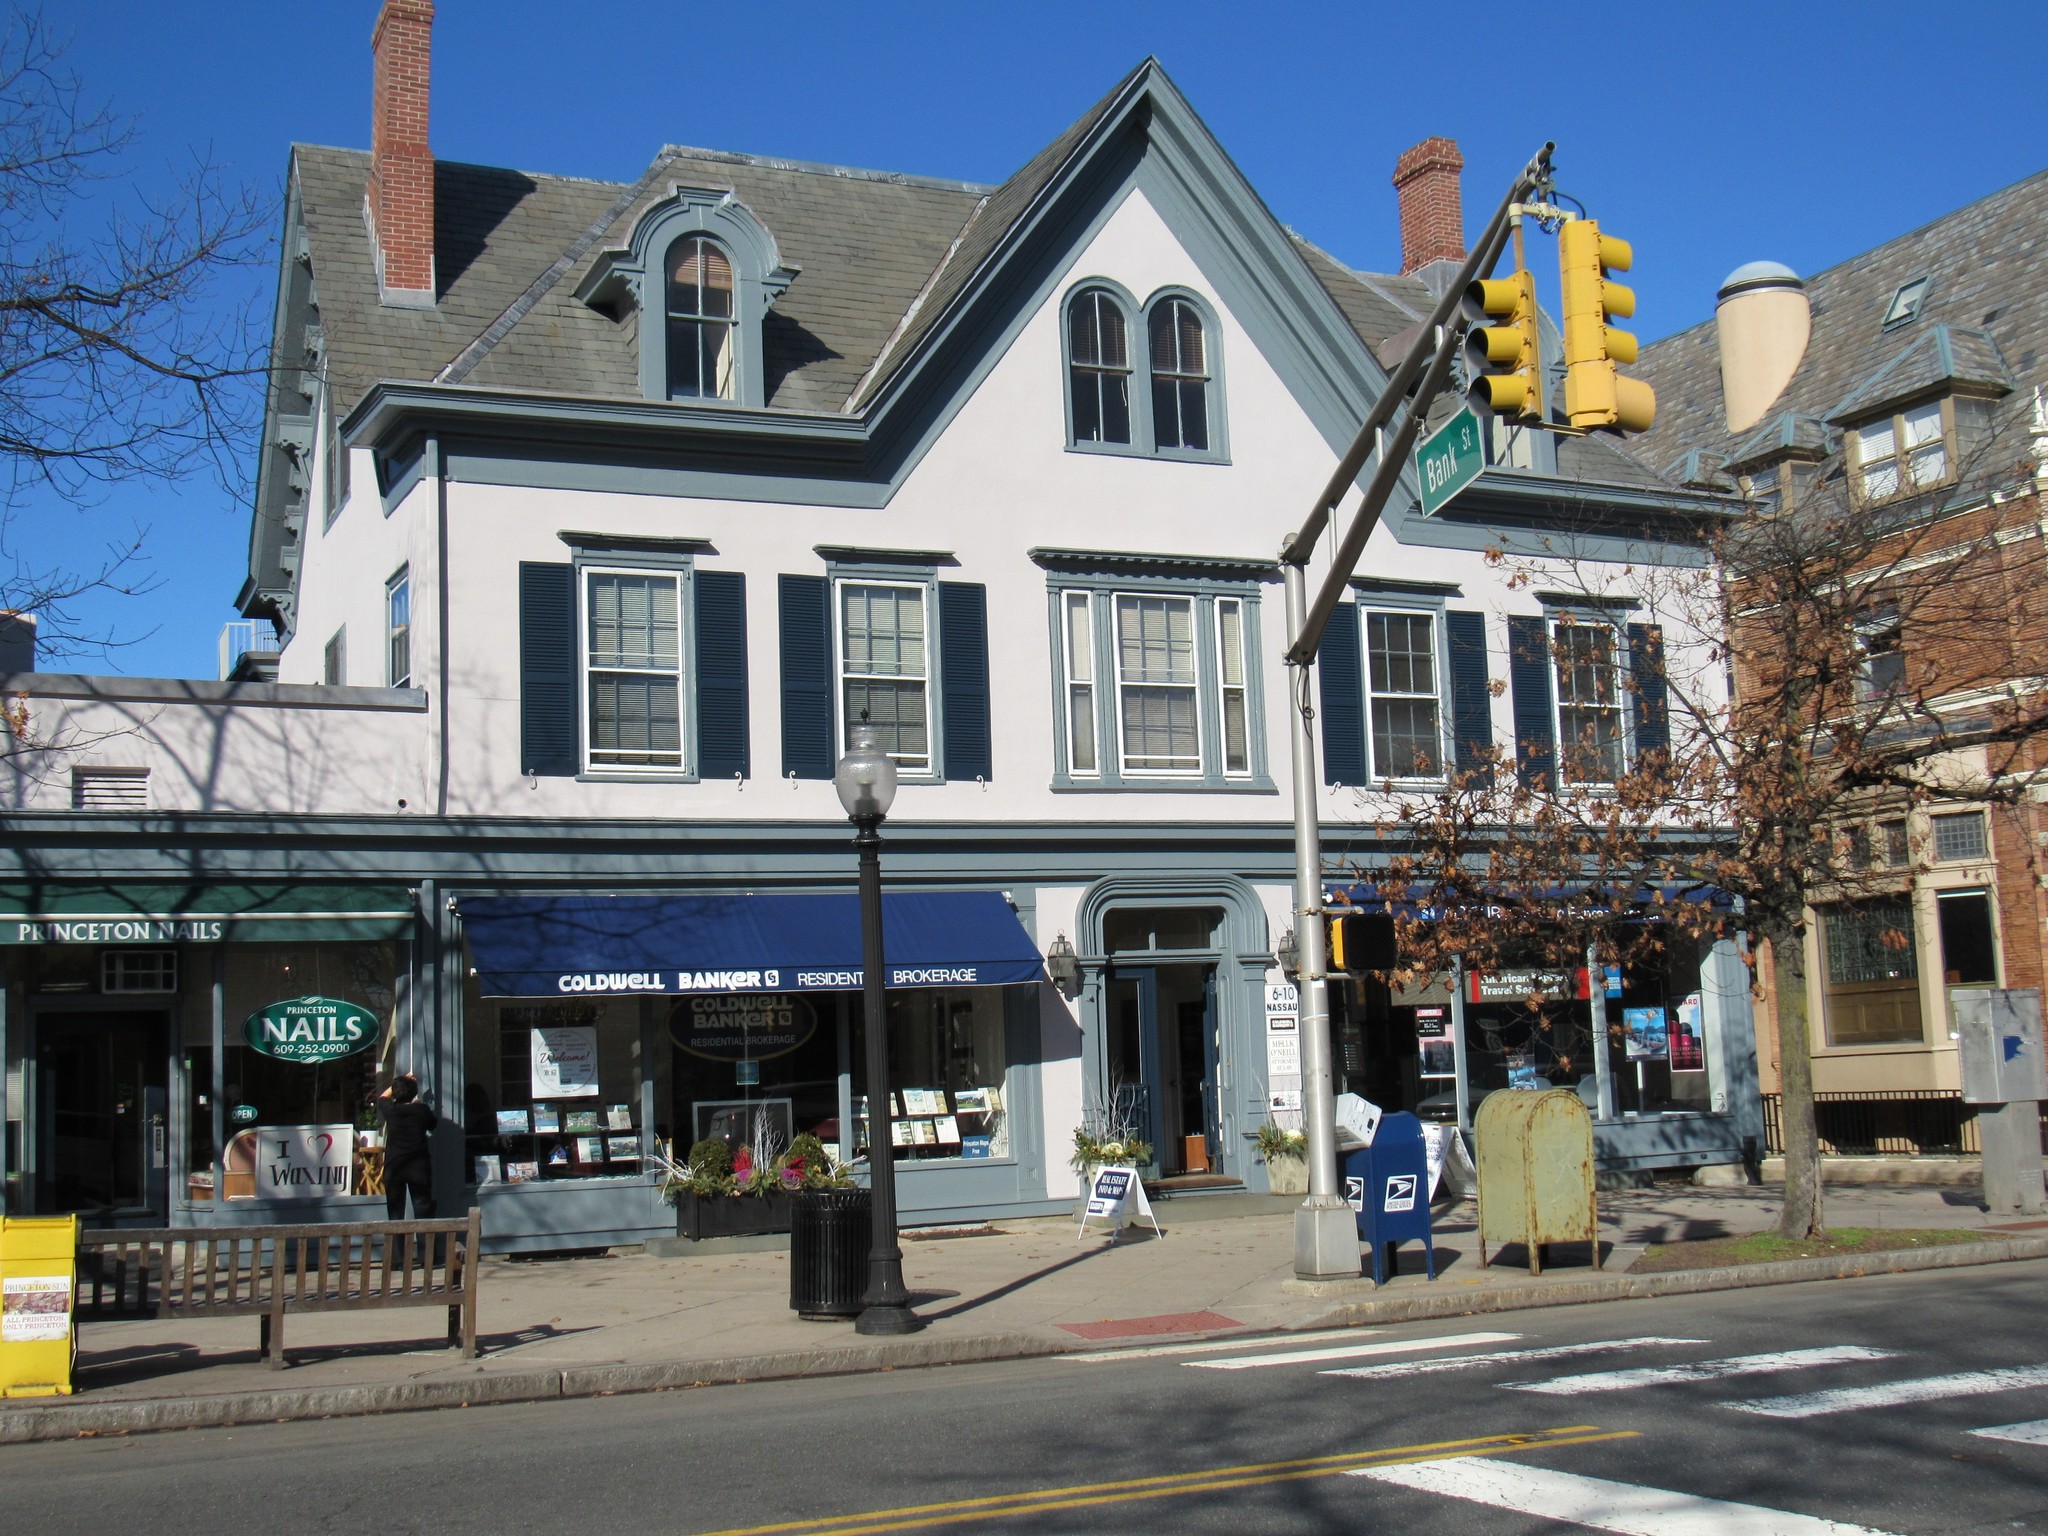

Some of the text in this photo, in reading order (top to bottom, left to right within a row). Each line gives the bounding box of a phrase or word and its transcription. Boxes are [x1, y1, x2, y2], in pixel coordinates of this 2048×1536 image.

[1427, 425, 1471, 493] Bank St
[19, 922, 221, 941] PRINCETON NAILS
[559, 968, 977, 992] COLDWELL BANKER RESIDENT BROKERAGE
[1272, 987, 1294, 1000] 6-10
[1481, 984, 1559, 996] Travel Serces
[691, 995, 793, 1012] COLDWELL
[1266, 1003, 1298, 1012] NASSAU
[286, 1006, 337, 1015] PRINCETON
[693, 1012, 775, 1029] BANKER
[263, 1016, 363, 1042] NAILS
[691, 1035, 797, 1047] RESIDENTIAL BROKERAGE
[274, 1043, 350, 1054] 609-252-0900
[1270, 1048, 1297, 1057] O'NEILL
[540, 1051, 590, 1064] Welcome!
[231, 1109, 253, 1119] OPEN
[276, 1140, 290, 1159] I
[5, 1283, 69, 1292] PRINCETON SUN
